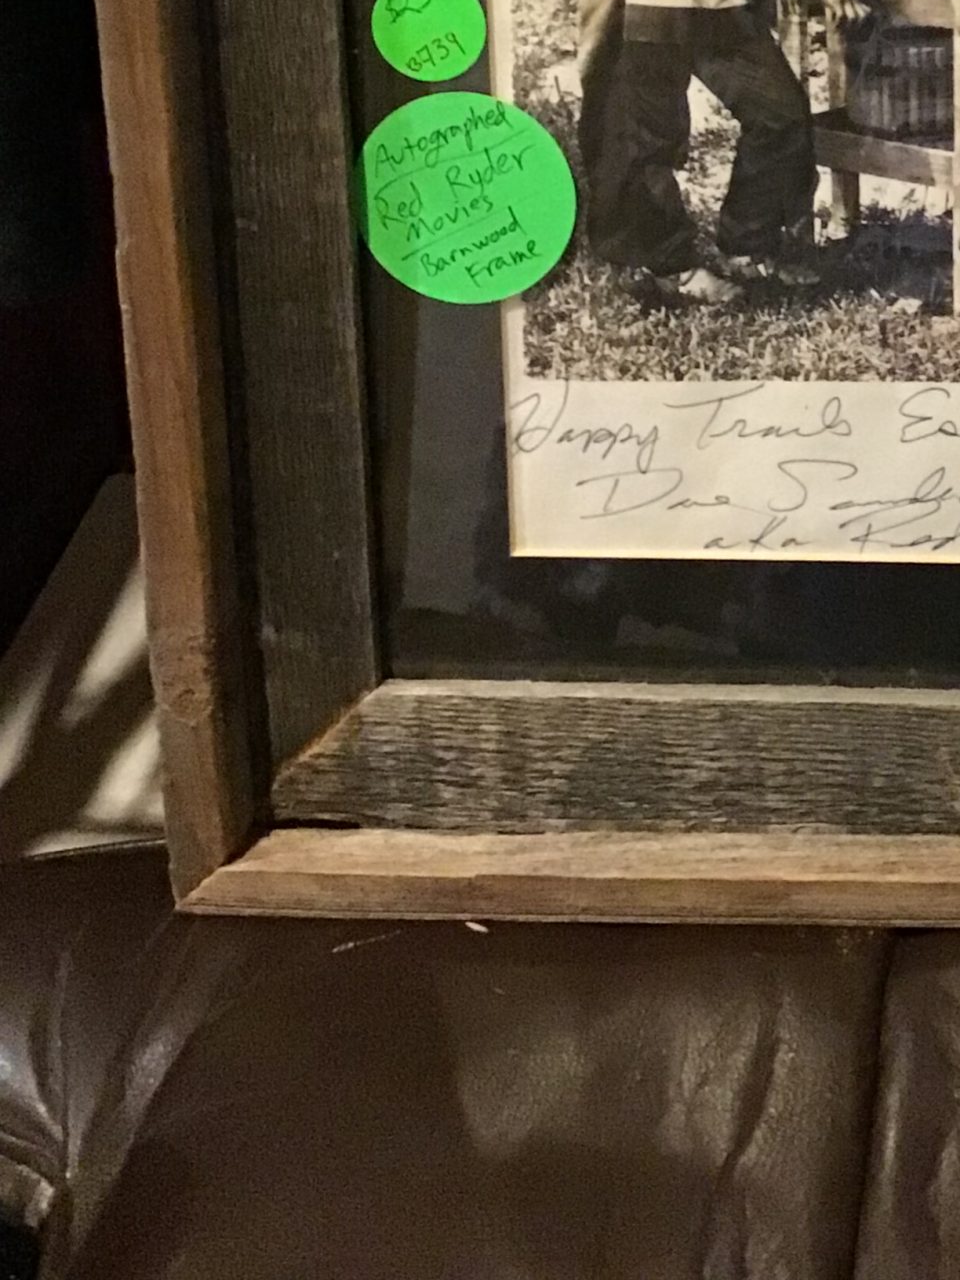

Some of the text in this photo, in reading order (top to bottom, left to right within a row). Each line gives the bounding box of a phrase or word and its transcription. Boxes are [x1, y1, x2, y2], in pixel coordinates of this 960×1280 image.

[374, 100, 514, 179] Autographed
[374, 144, 537, 231] Red Ryder
[406, 194, 493, 243] Movies
[421, 206, 525, 277] Barnwood
[465, 239, 542, 288] Frame
[510, 378, 658, 474] Happy
[663, 383, 852, 450] Trails
